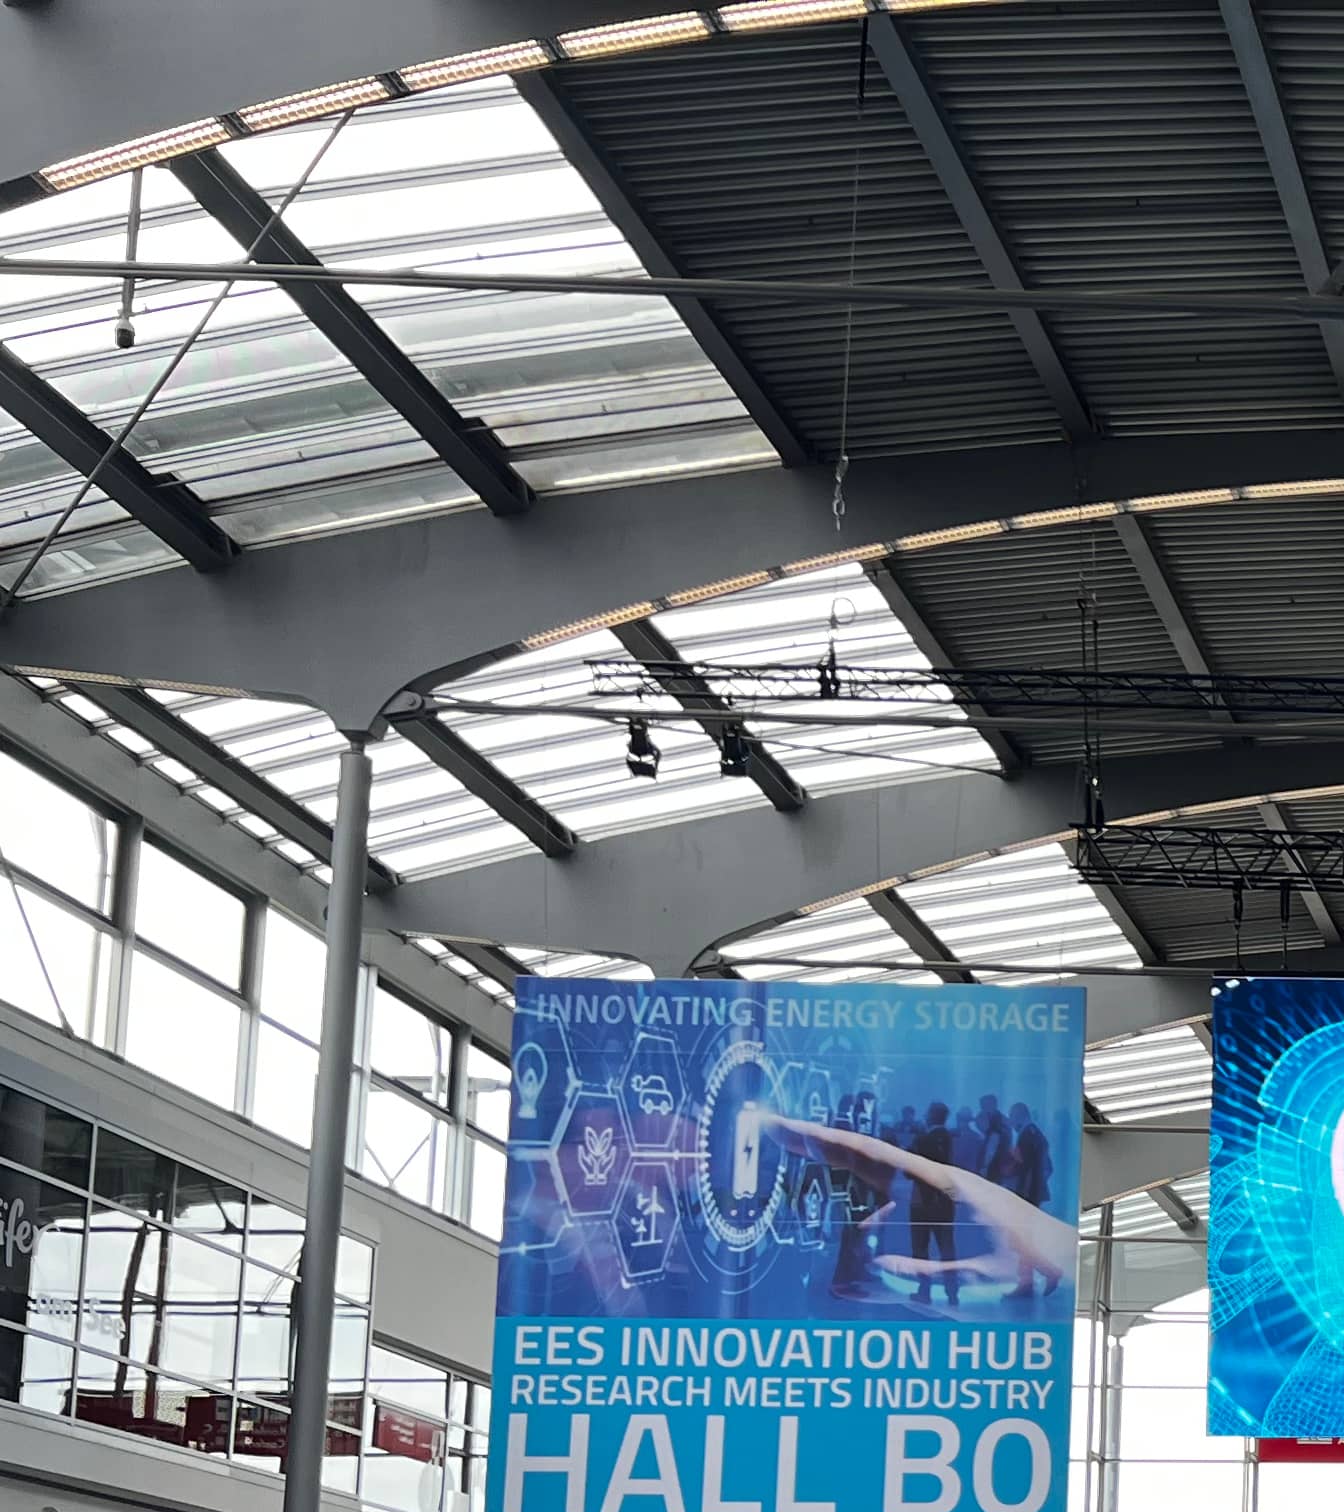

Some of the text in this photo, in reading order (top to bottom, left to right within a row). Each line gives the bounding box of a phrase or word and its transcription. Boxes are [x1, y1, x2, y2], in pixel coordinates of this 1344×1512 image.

[538, 994, 1069, 1032] INNOVATING ENERGY STORAGE
[515, 1326, 1053, 1369] EES INNOVATION HUB
[511, 1376, 1054, 1409] RESEARCH MEETS INDUSTRY
